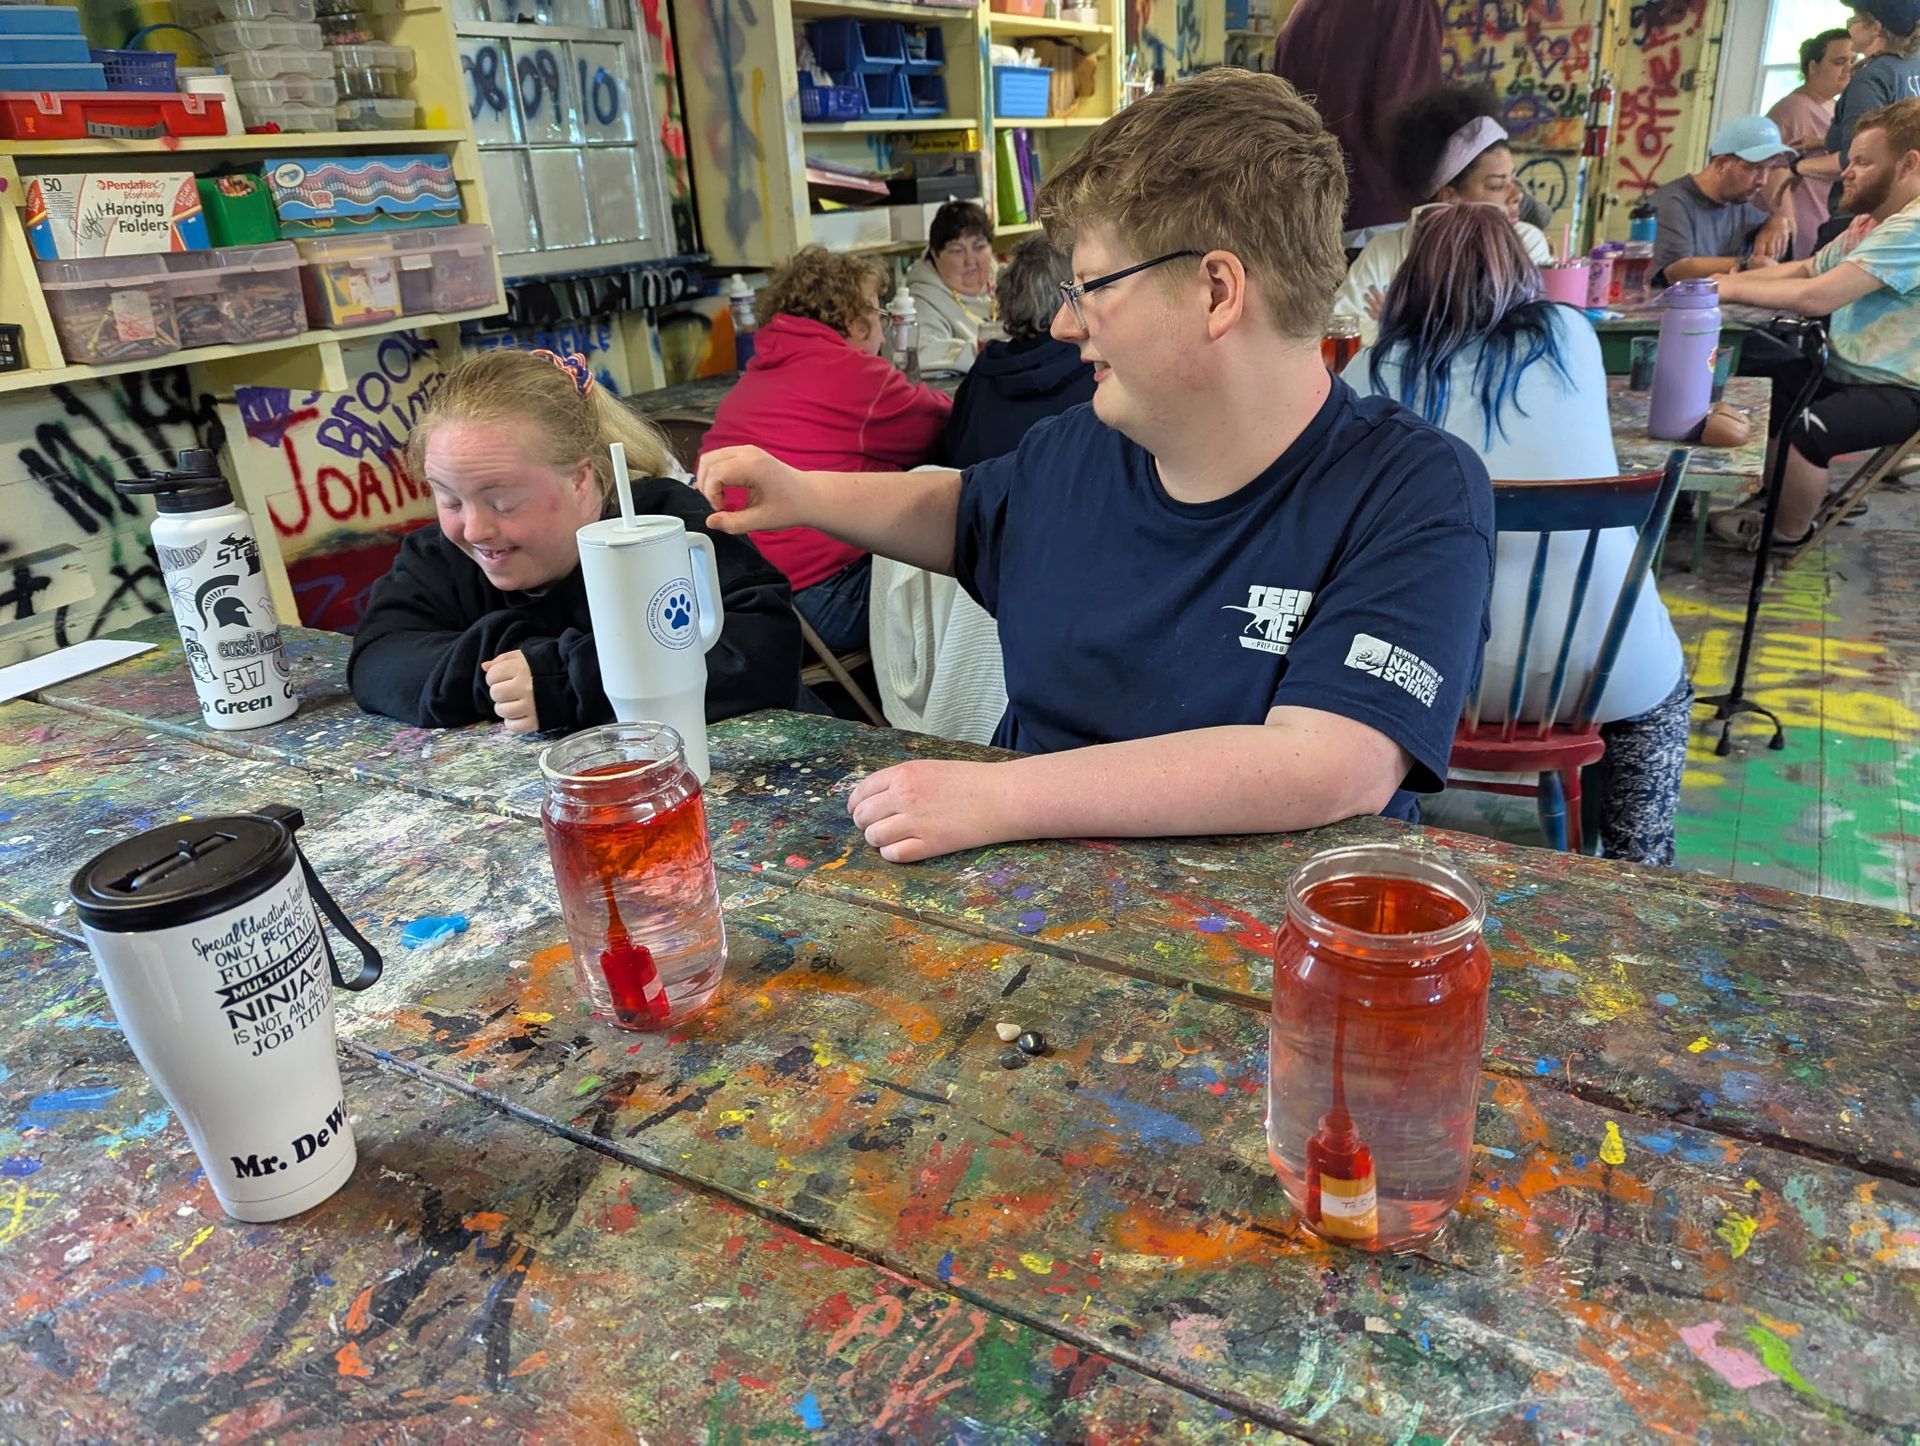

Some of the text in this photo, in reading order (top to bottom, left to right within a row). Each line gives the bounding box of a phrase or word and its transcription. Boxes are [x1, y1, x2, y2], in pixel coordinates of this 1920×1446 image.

[518, 49, 562, 124] 09
[578, 59, 618, 125] 10
[43, 177, 62, 192] 50
[107, 180, 159, 190] Pendaflex
[124, 190, 163, 199] Essentials
[105, 201, 164, 217] Hanging
[119, 219, 169, 233] Folders
[650, 598, 660, 629] MICHIGAN
[659, 582, 678, 598] ANIMAL
[1393, 645, 1420, 664] DENVER
[224, 660, 265, 694] 517
[1382, 667, 1435, 708] SCIENCE
[1388, 654, 1436, 691] NATURE
[214, 695, 273, 714] Green
[192, 918, 242, 961] Special
[241, 899, 291, 938] Education
[215, 900, 308, 968] ONLY BECAUSE
[217, 911, 316, 986] FULL TIME
[231, 934, 320, 1001] MULTITASKING
[227, 968, 315, 1030] NINJA
[233, 1029, 251, 1046] IS
[254, 1012, 284, 1037] NOT
[289, 999, 307, 1020] AN
[252, 1024, 294, 1057] JOB
[230, 1154, 288, 1178] Mr.
